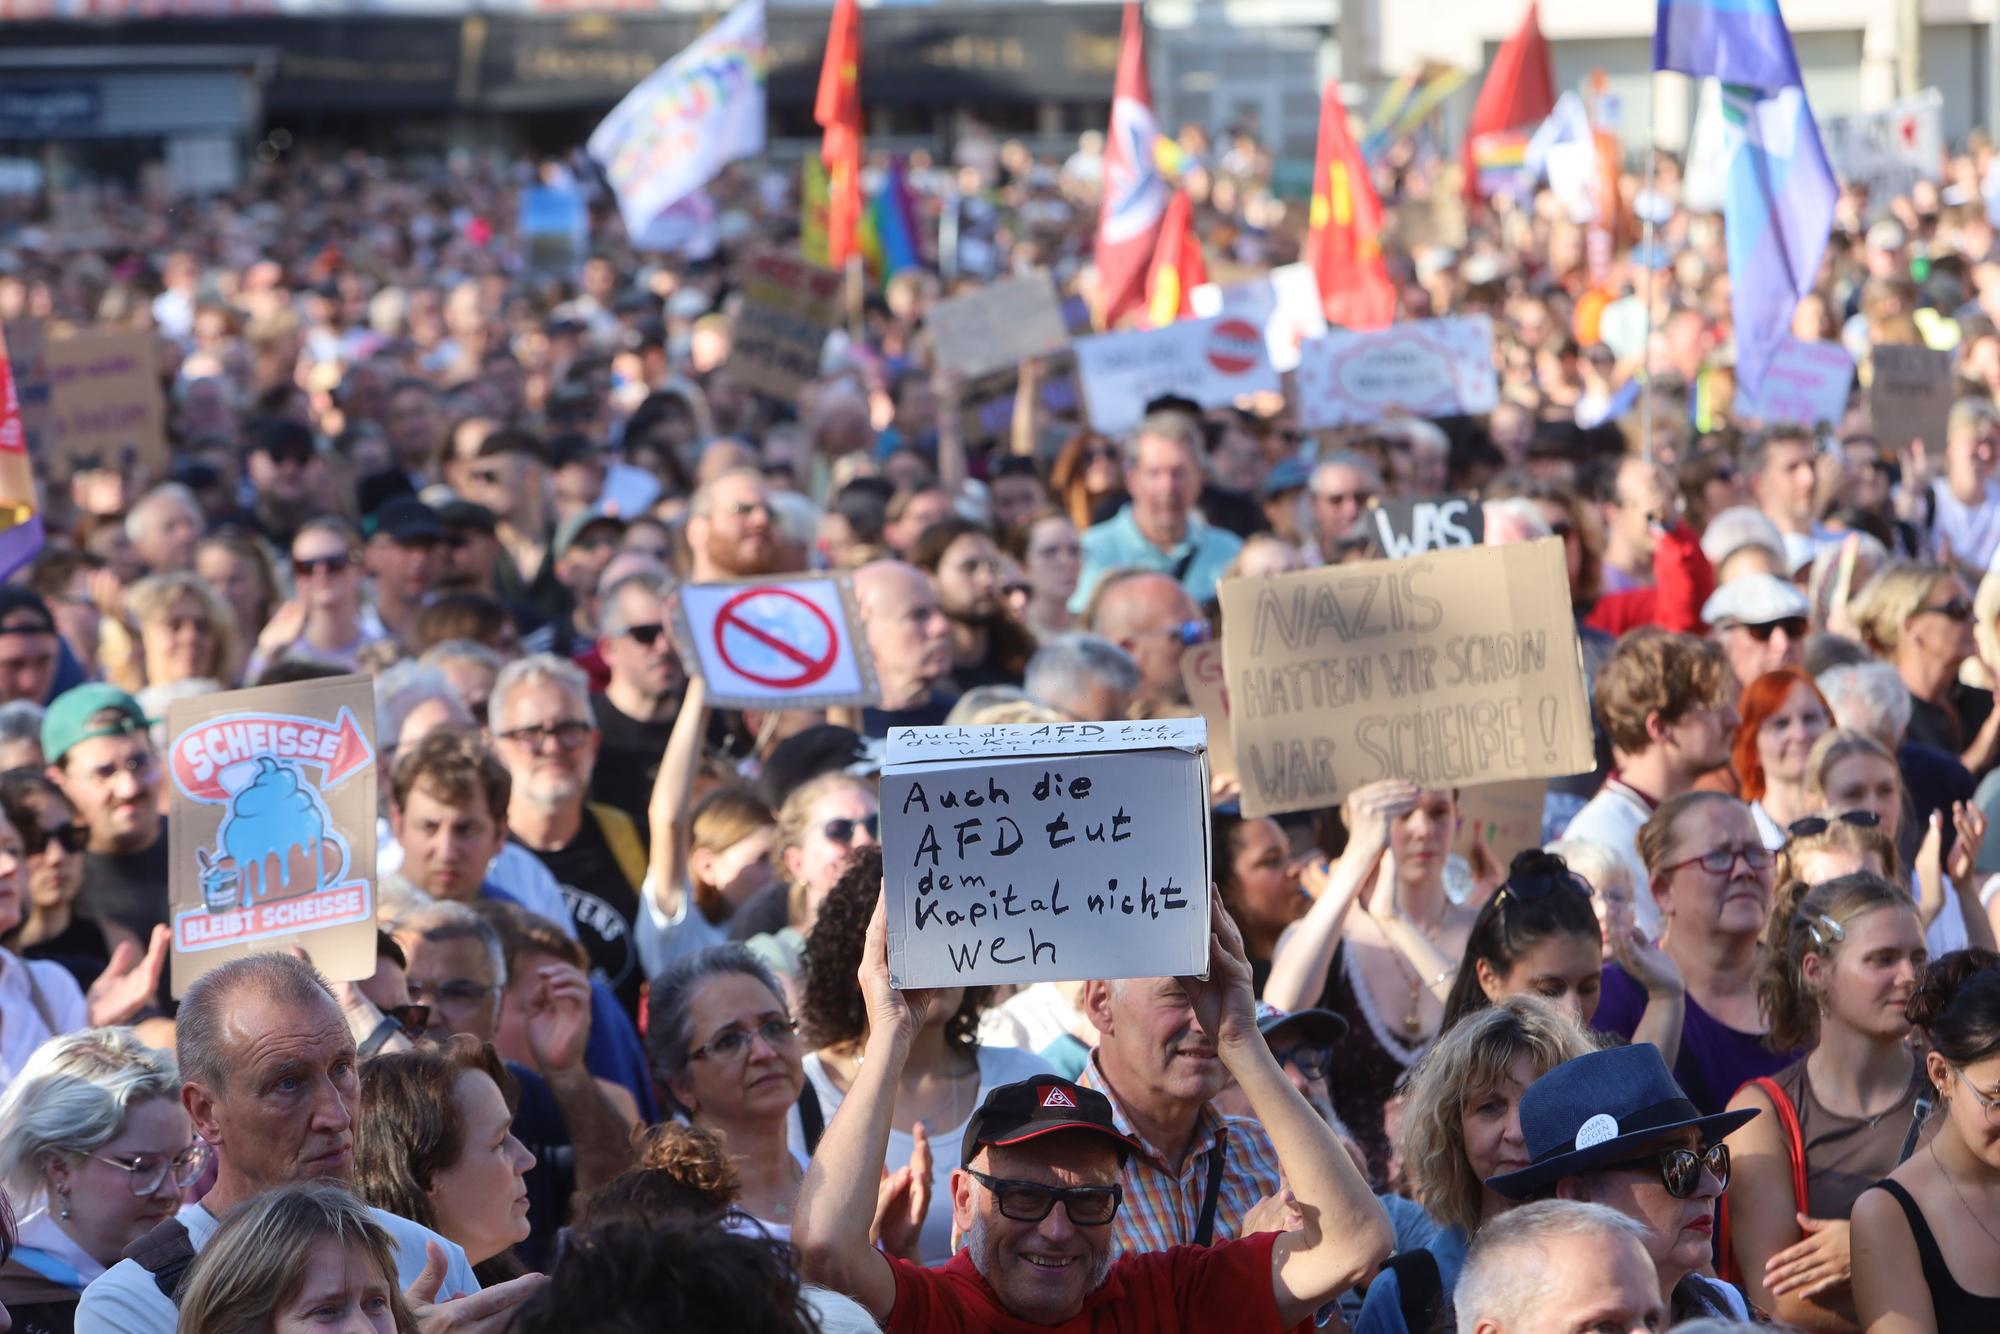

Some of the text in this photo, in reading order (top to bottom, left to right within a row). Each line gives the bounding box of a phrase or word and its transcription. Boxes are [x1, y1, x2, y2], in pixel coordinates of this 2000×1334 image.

[1375, 500, 1474, 560] WAS
[1251, 562, 1444, 657] NAZIS
[1242, 653, 1373, 720] HATTEN
[1380, 645, 1438, 698] WIR
[1446, 630, 1547, 687] SCHON
[182, 723, 342, 782] SCHEISSE
[897, 727, 971, 741] Auch
[1030, 725, 1105, 737] AFD
[1120, 724, 1169, 734] tut
[906, 738, 970, 747] dem
[1122, 730, 1185, 741] nicht
[902, 771, 1092, 815] Auch die
[1251, 735, 1338, 801] WAR
[913, 805, 1132, 867] AFD tut
[914, 876, 1188, 931] Kapital nicht
[917, 867, 986, 896] dem
[184, 911, 256, 943] BLEIBT
[262, 892, 361, 928] SCHEISSE
[948, 928, 1057, 973] weh
[1580, 1117, 1606, 1137] OMAS
[1581, 1124, 1610, 1146] GEGEN
